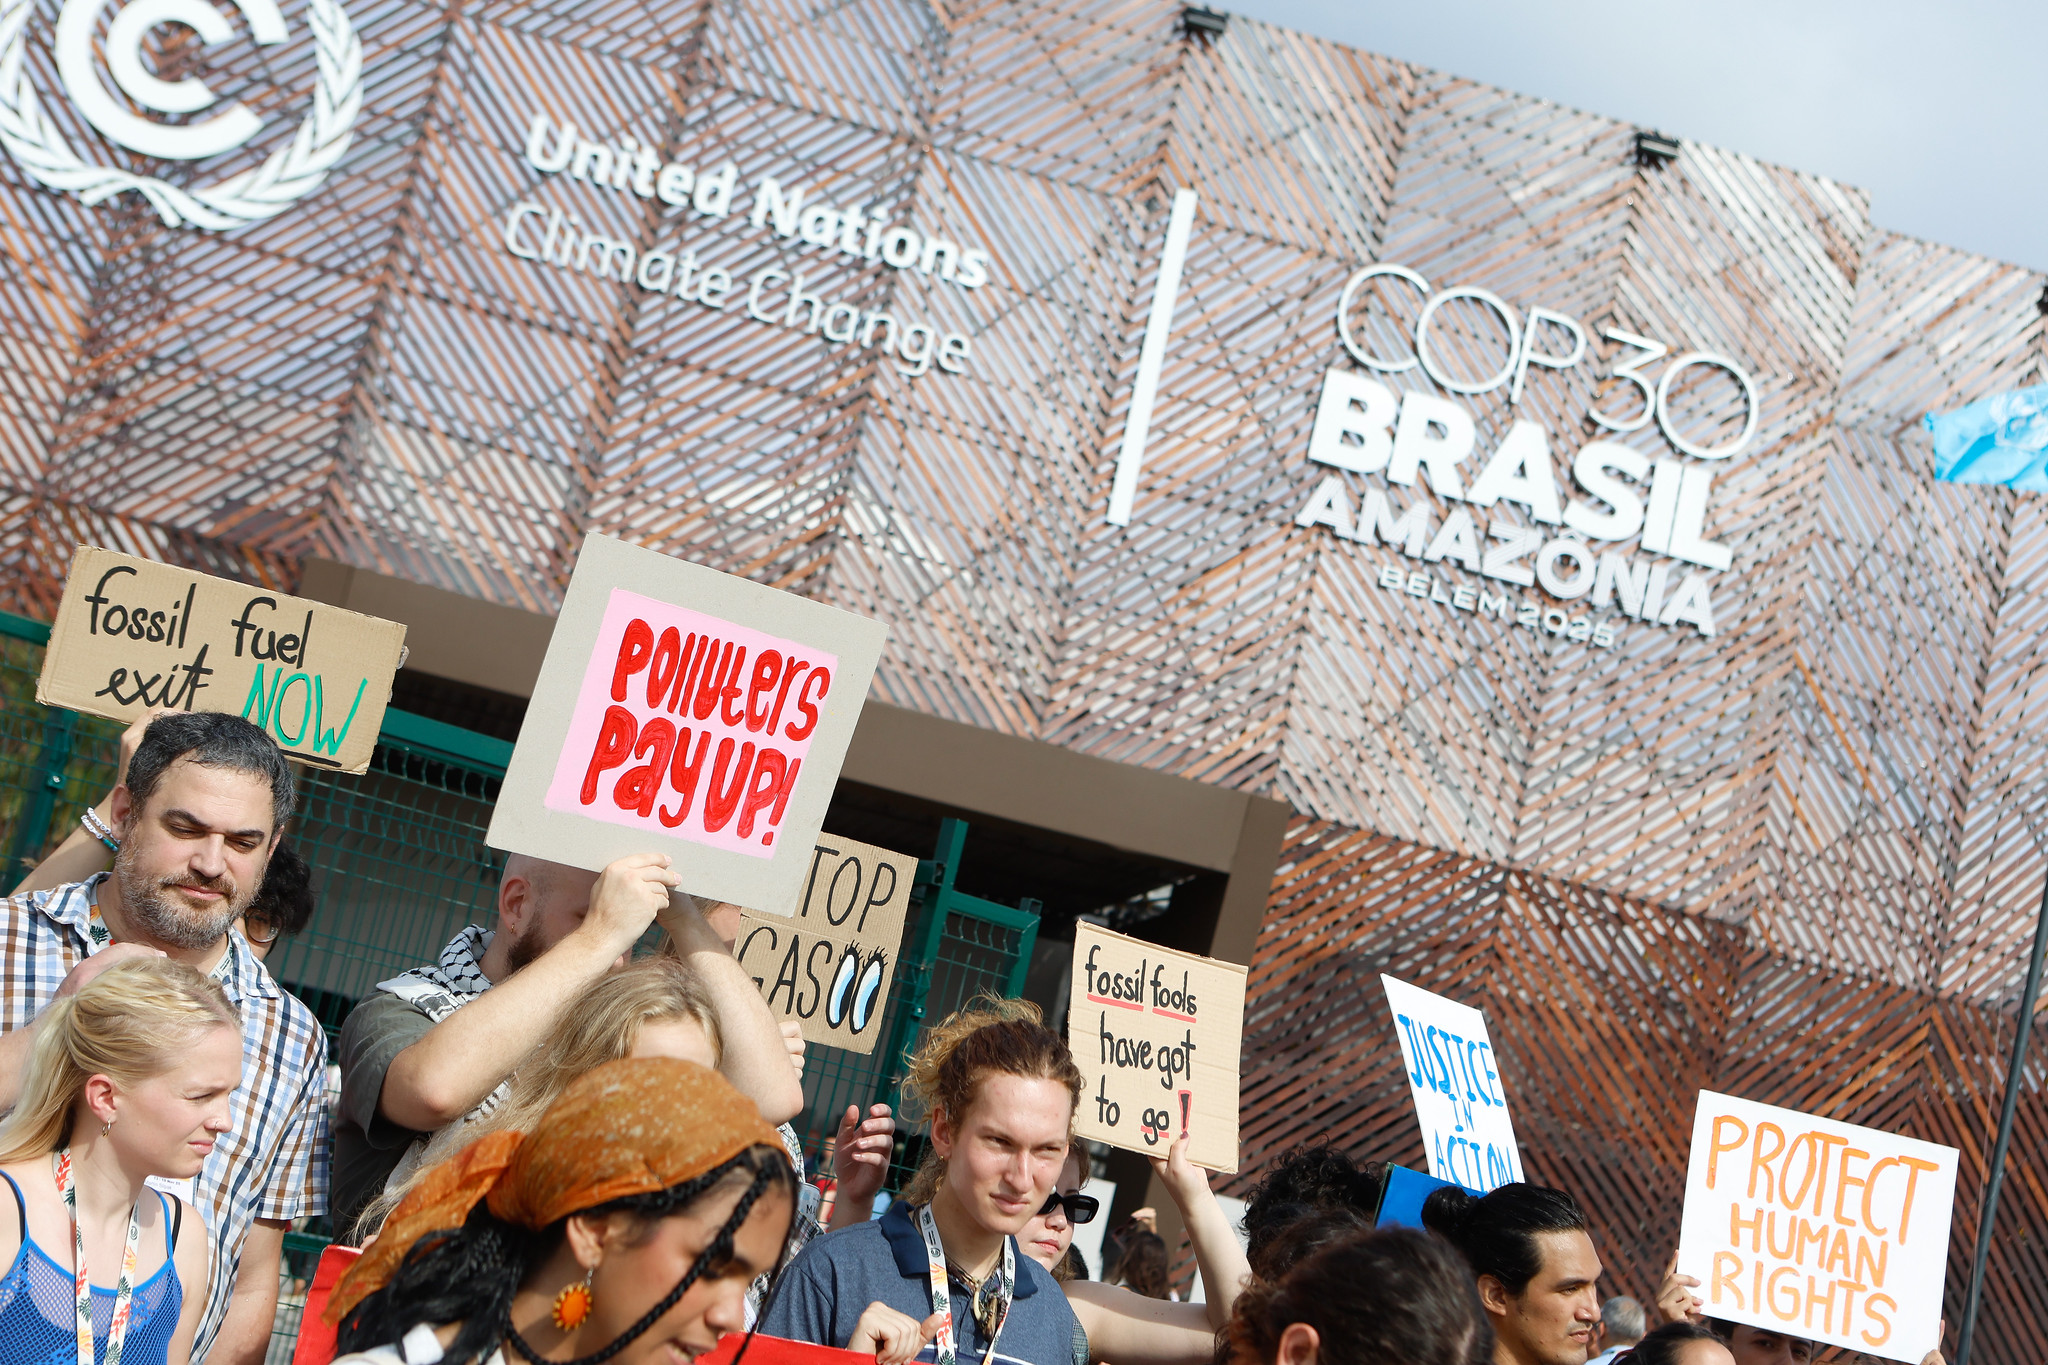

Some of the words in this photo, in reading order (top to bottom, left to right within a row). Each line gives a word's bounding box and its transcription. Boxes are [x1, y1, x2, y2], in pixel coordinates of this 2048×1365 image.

[526, 114, 738, 219] United
[750, 177, 991, 289] Nations
[503, 201, 732, 308] Climate
[747, 268, 972, 377] Change
[1337, 262, 1587, 404] COP
[1588, 326, 1759, 460] 30
[1308, 368, 1734, 572] BRASIL
[1295, 475, 1716, 637] AMAZÔNIA
[85, 566, 197, 649] fossil
[231, 597, 313, 669] fuel
[1379, 564, 1508, 618] BELÉM
[1516, 601, 1616, 648] 2025
[95, 643, 213, 712] exit
[242, 663, 368, 756] NOW
[801, 845, 897, 933] TOP
[1085, 944, 1147, 1003] fossil
[1149, 964, 1197, 1016] fools
[1100, 1010, 1153, 1070] have
[1157, 1029, 1196, 1090] got
[1397, 1013, 1504, 1107] JUSTICE
[1096, 1074, 1121, 1127] to
[1448, 1093, 1475, 1133] IN
[1435, 1128, 1514, 1193] ACTION
[1706, 1115, 1940, 1246] PROTECT
[1730, 1202, 1889, 1289] HUMAN
[1710, 1251, 1898, 1347] RIGHTS
